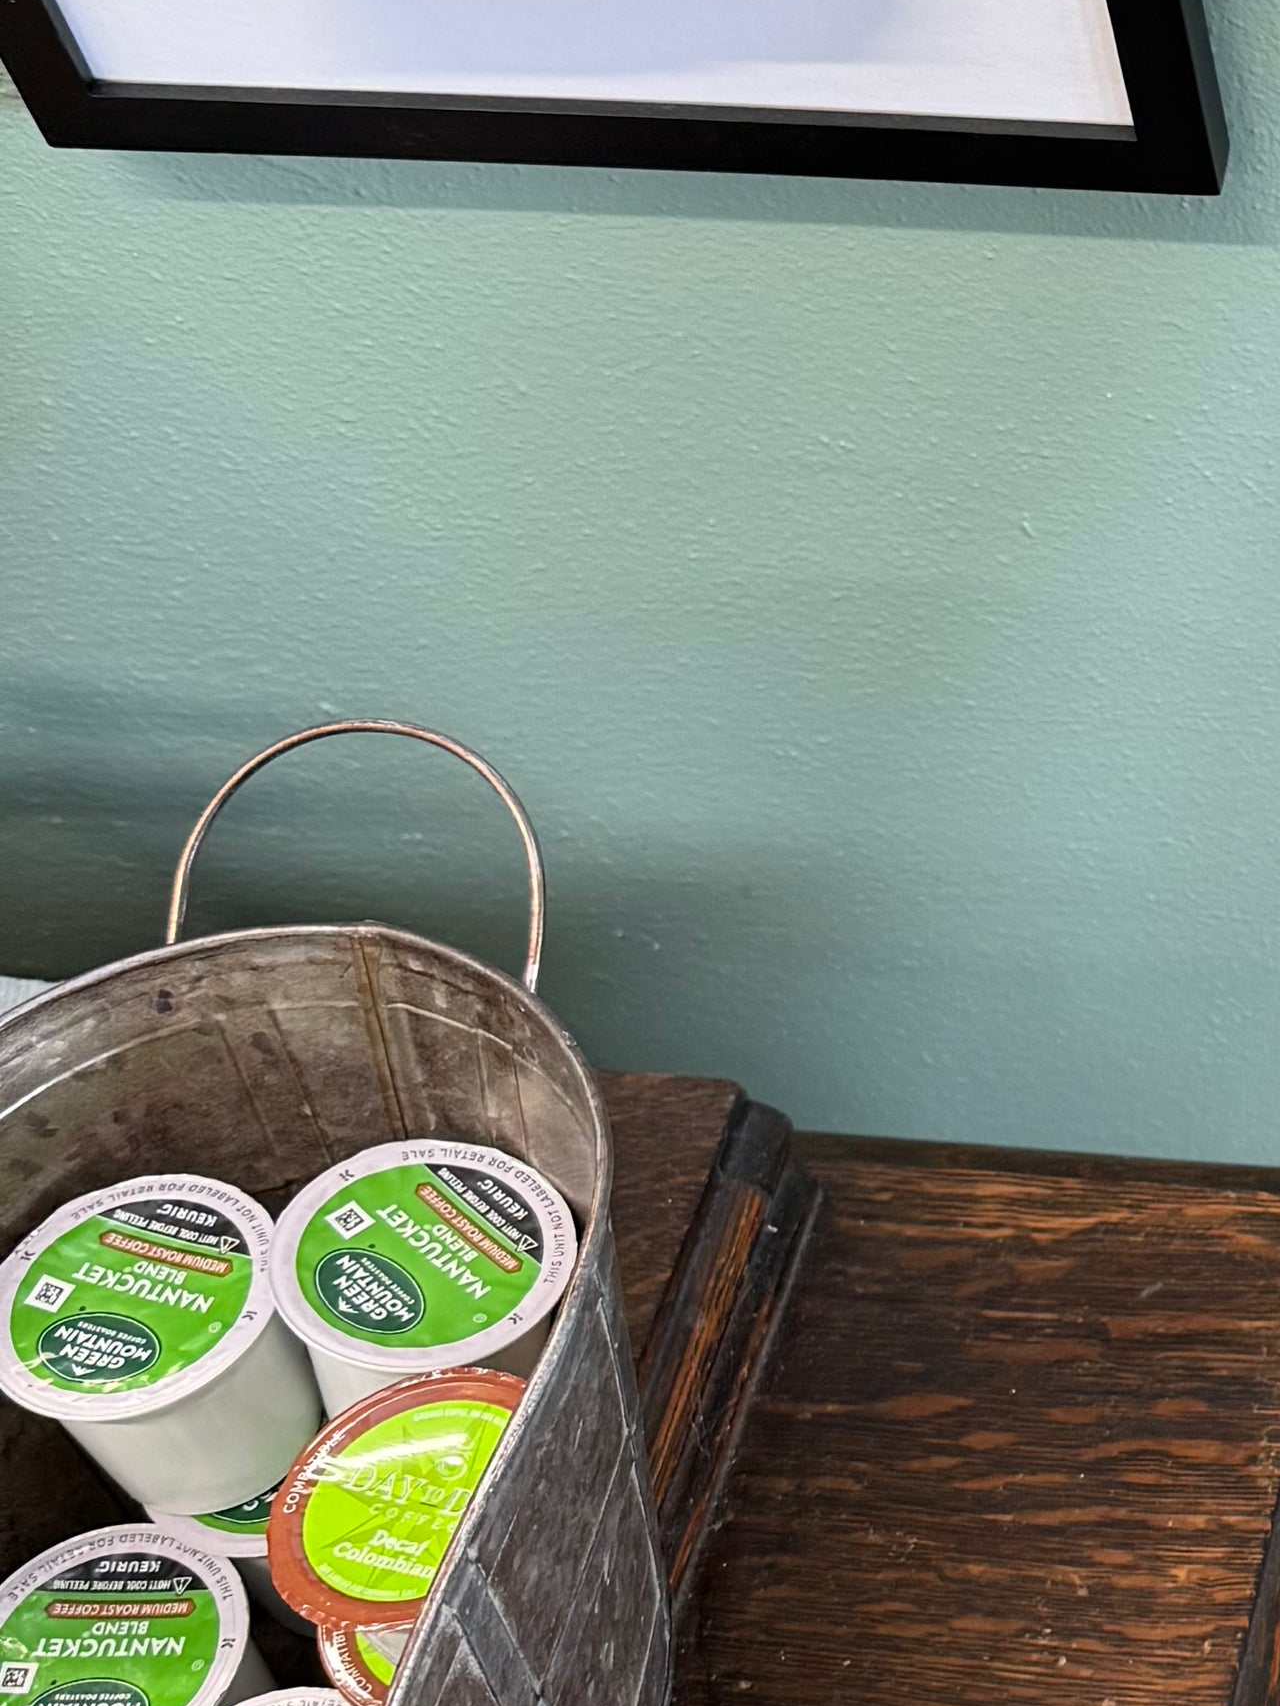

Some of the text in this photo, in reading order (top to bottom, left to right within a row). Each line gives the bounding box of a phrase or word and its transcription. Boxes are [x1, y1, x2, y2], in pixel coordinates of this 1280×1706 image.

[109, 1184, 153, 1202] RETAIL
[158, 1183, 185, 1192] FOR
[189, 1184, 239, 1206] LABELED
[71, 1200, 104, 1220] SALE
[477, 1179, 529, 1221] KEURIG
[157, 1203, 218, 1228] KEURIG
[237, 1204, 256, 1225] NOT
[402, 1148, 565, 1284] THIS UNIT NOT LABELED FOR RETAIL SALE
[252, 1223, 270, 1246] UNIT
[420, 1186, 519, 1269] MEDIUM ROAST COFFEE
[105, 1232, 229, 1273] MEDIUM ROAST COFFEE
[376, 1204, 492, 1300] NANTUCKET
[432, 1224, 479, 1263] BLEND
[133, 1261, 188, 1285] BLEND
[72, 1262, 215, 1314] NANTUCKET
[333, 1275, 388, 1320] GREEN
[336, 1254, 415, 1322] MOUNTAIN
[54, 1326, 152, 1362] MOUNTAIN
[60, 1345, 125, 1370] GREEN
[89, 1536, 114, 1550] FOR
[119, 1533, 175, 1545] LABELED
[368, 1529, 431, 1555] Decaf
[95, 1561, 162, 1573] KEURIG
[197, 1553, 222, 1576] UNIT
[332, 1541, 436, 1579] Colombian
[7, 1573, 38, 1601] SALE
[217, 1576, 234, 1600] THIS
[53, 1603, 188, 1615] MEDIUM ROAST COFFEE
[92, 1621, 149, 1635] BLEND
[30, 1636, 186, 1657] NANTUCKET
